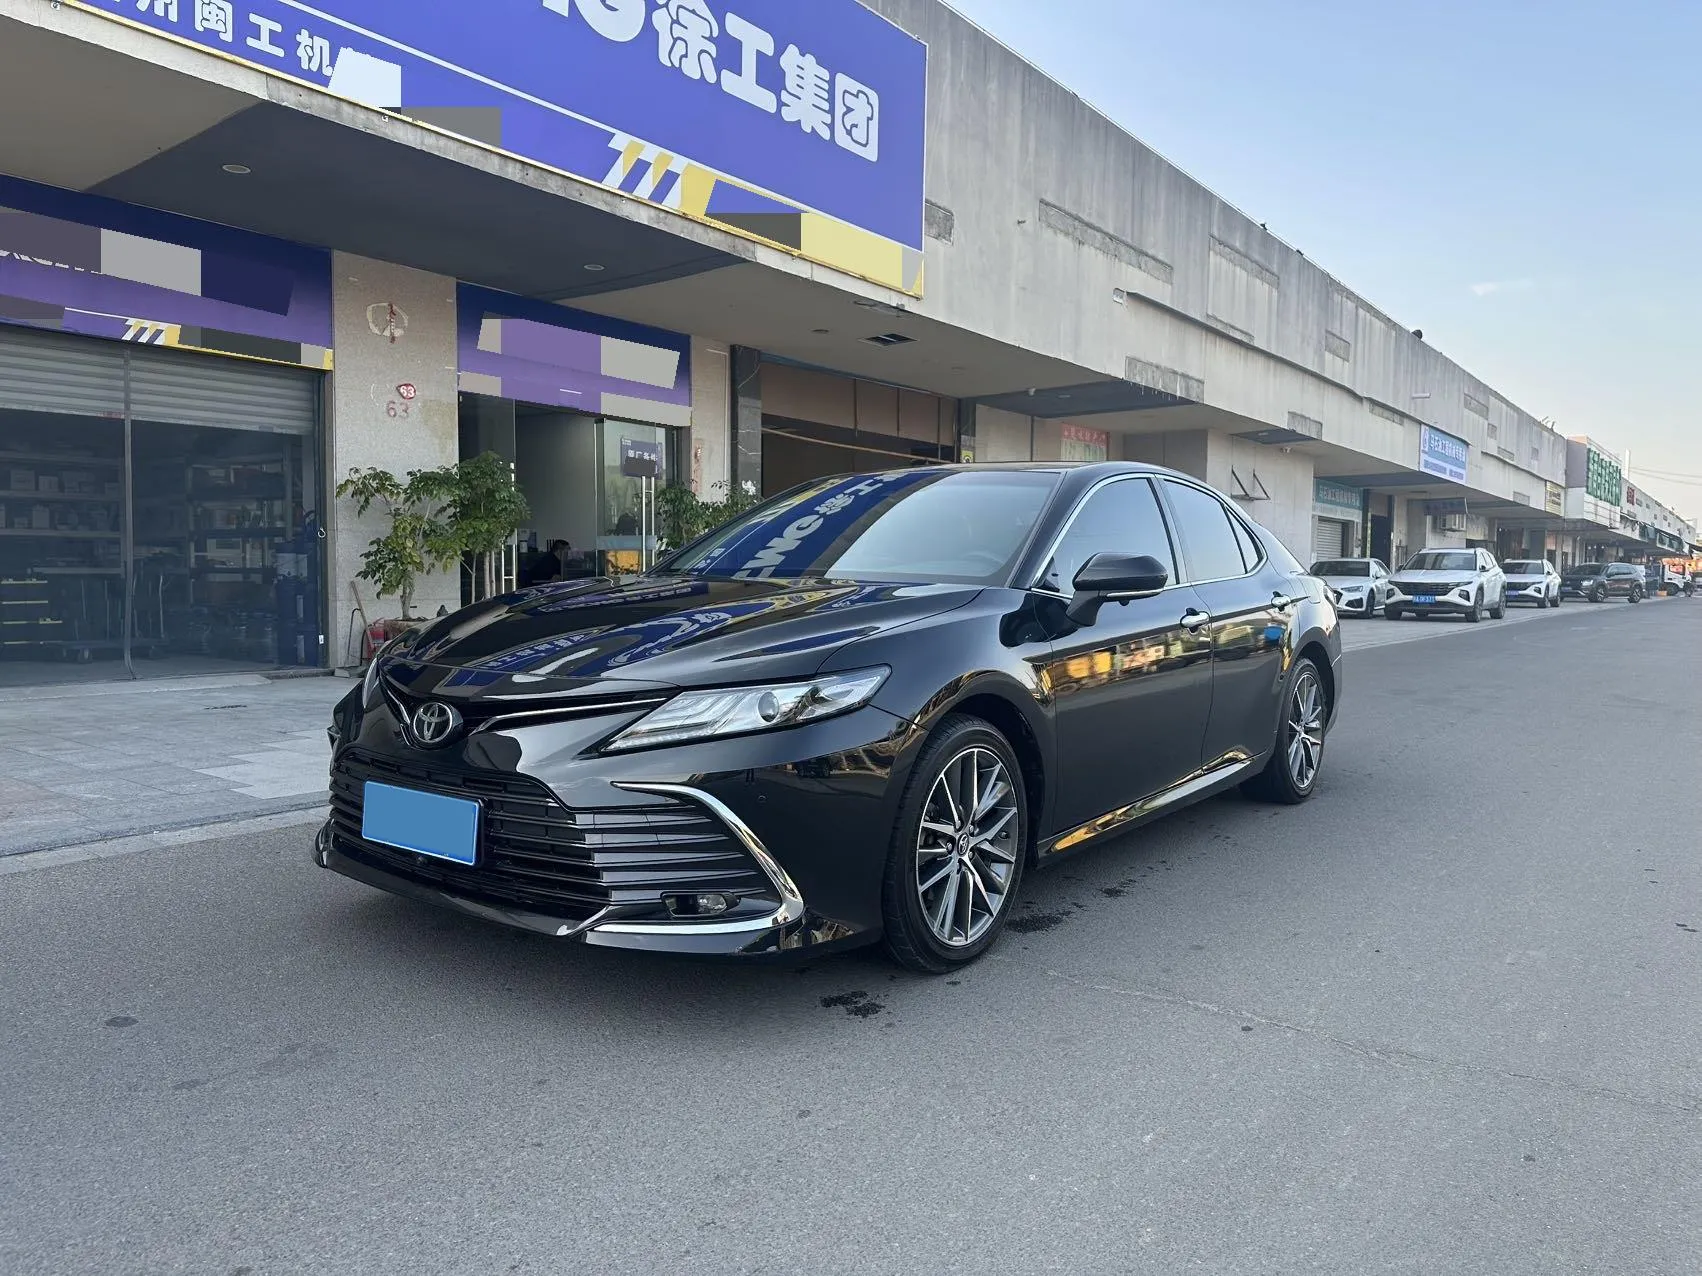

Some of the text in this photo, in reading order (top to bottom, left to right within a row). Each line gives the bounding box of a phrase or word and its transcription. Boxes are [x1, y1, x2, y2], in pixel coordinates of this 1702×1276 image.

[652, 0, 879, 162] 徐工集团
[400, 385, 415, 398] 63
[387, 400, 410, 418] 63
